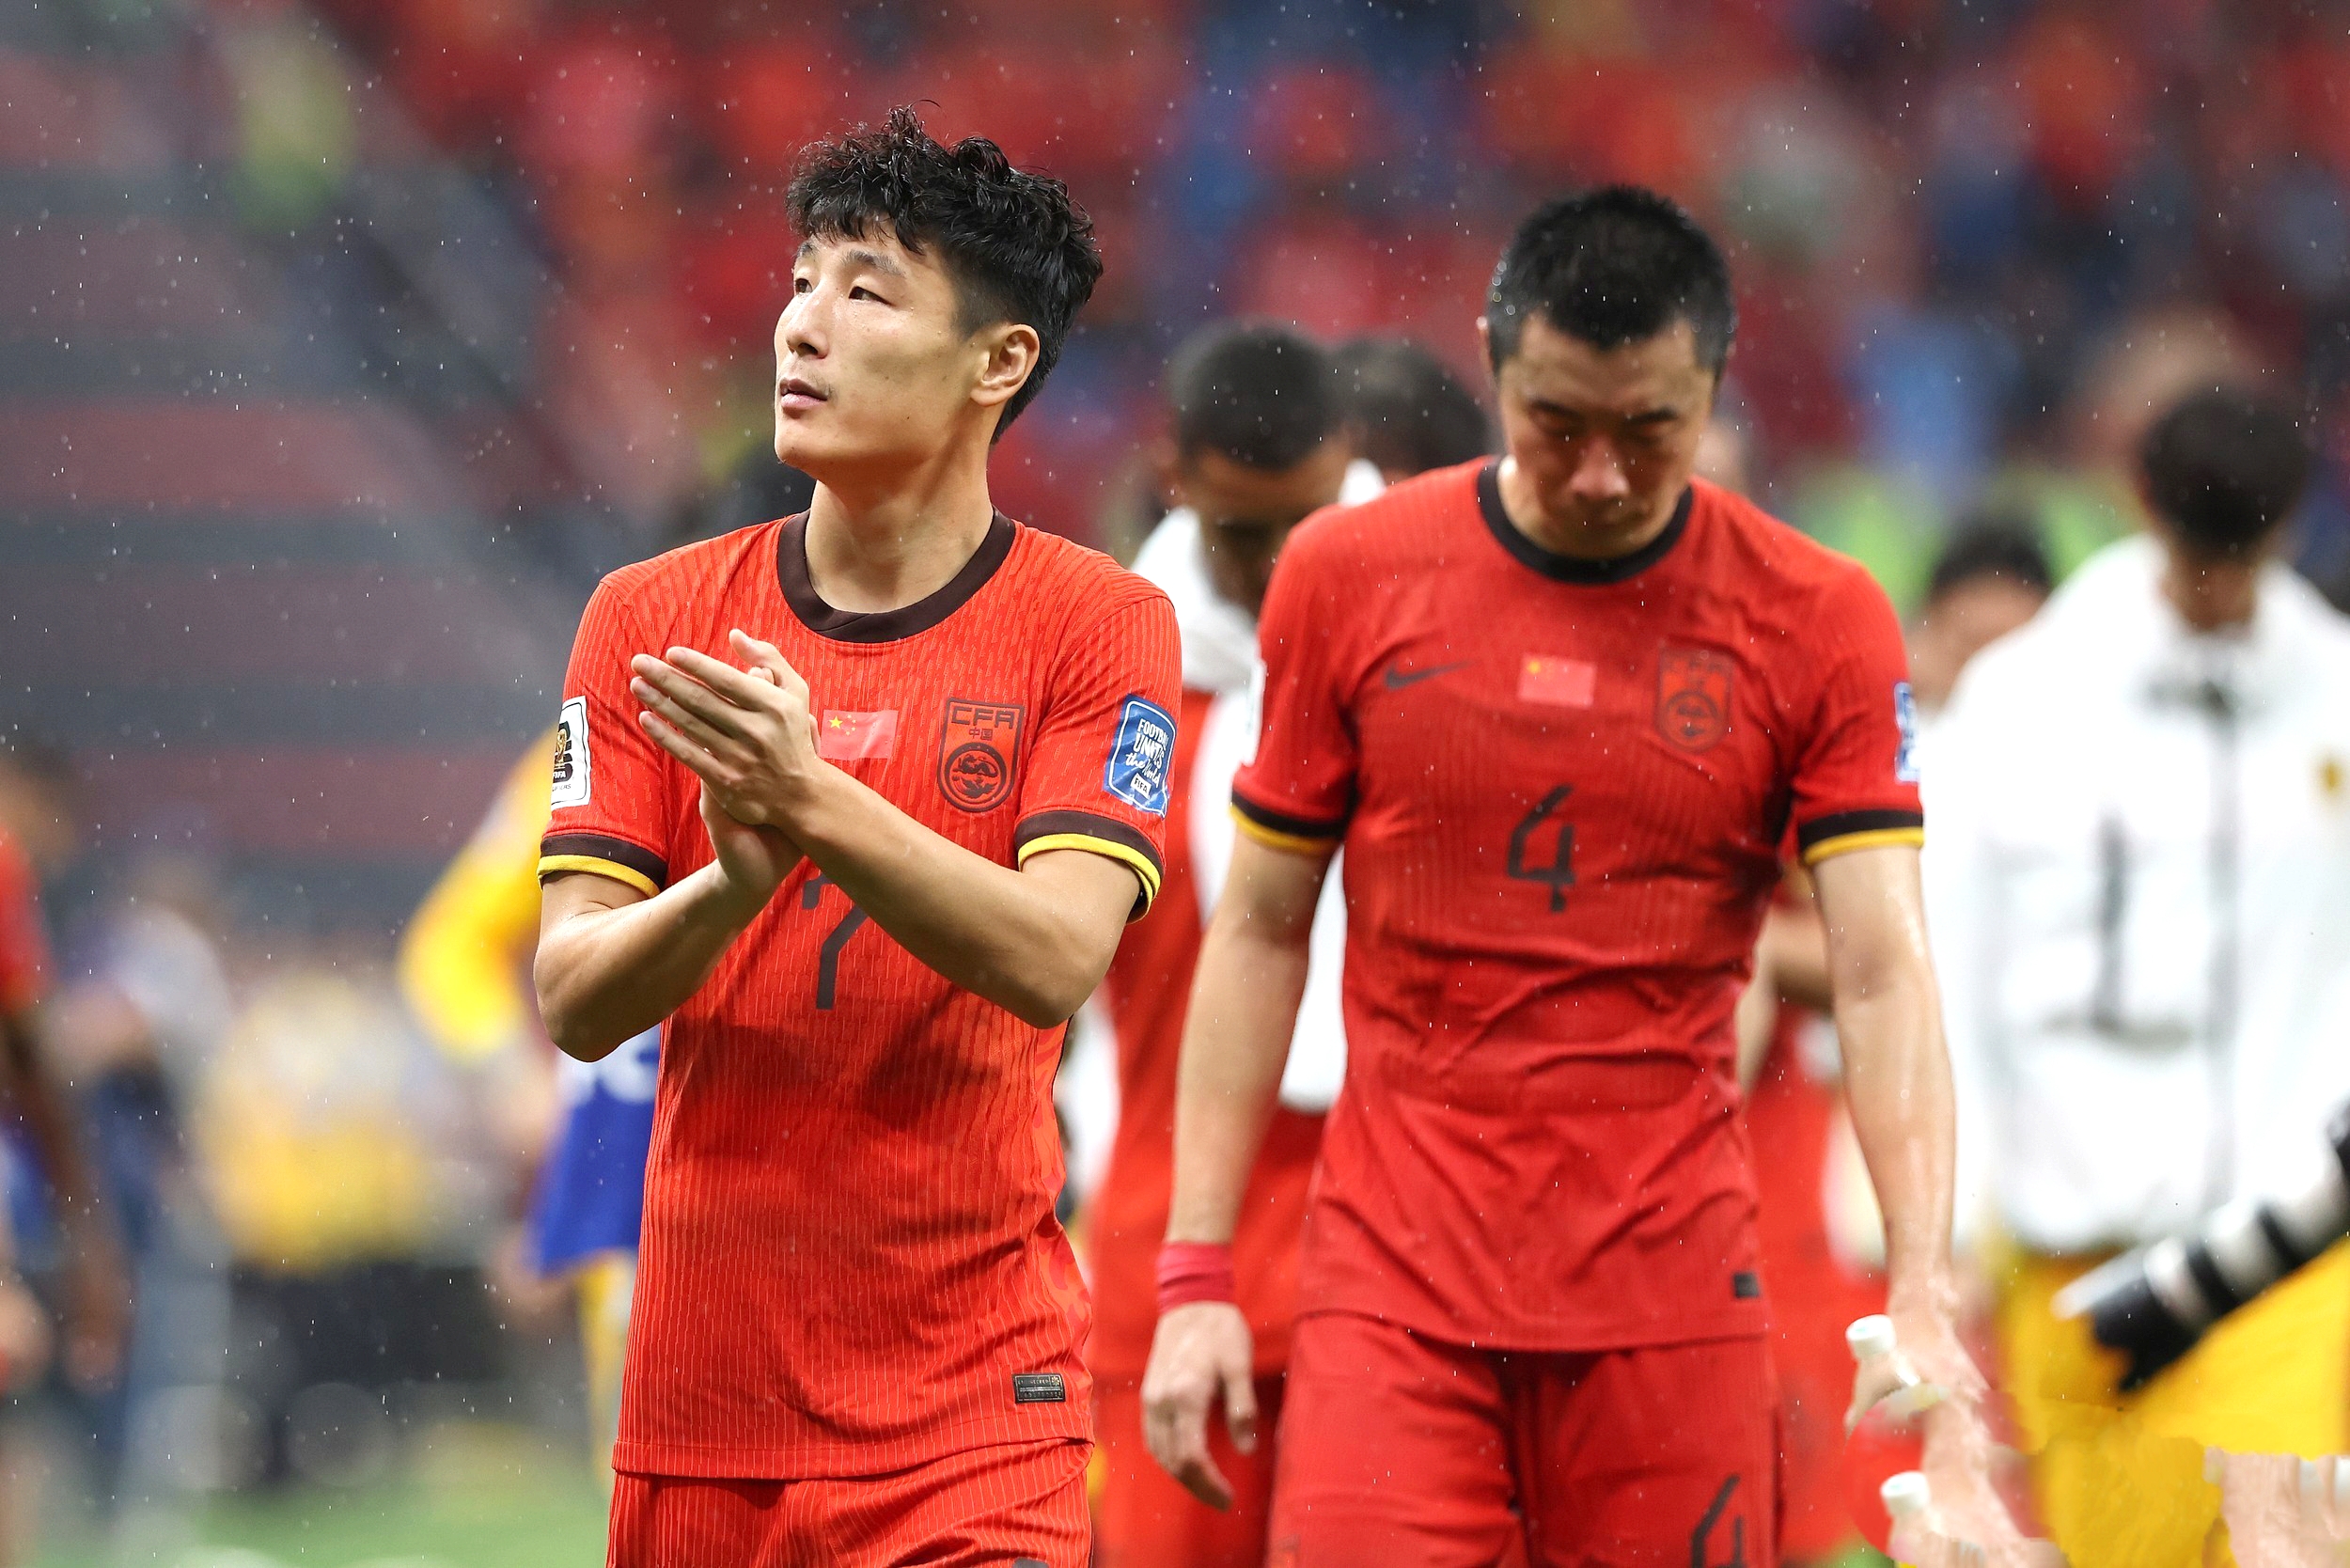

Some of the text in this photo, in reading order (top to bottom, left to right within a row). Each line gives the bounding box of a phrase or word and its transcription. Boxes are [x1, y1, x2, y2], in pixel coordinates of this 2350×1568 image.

[951, 706, 1015, 729] CFA
[969, 728, 993, 741] 中国
[1125, 752, 1146, 769] the
[1135, 777, 1148, 793] FIFA
[1508, 783, 1575, 913] 4
[802, 872, 869, 1010] 7
